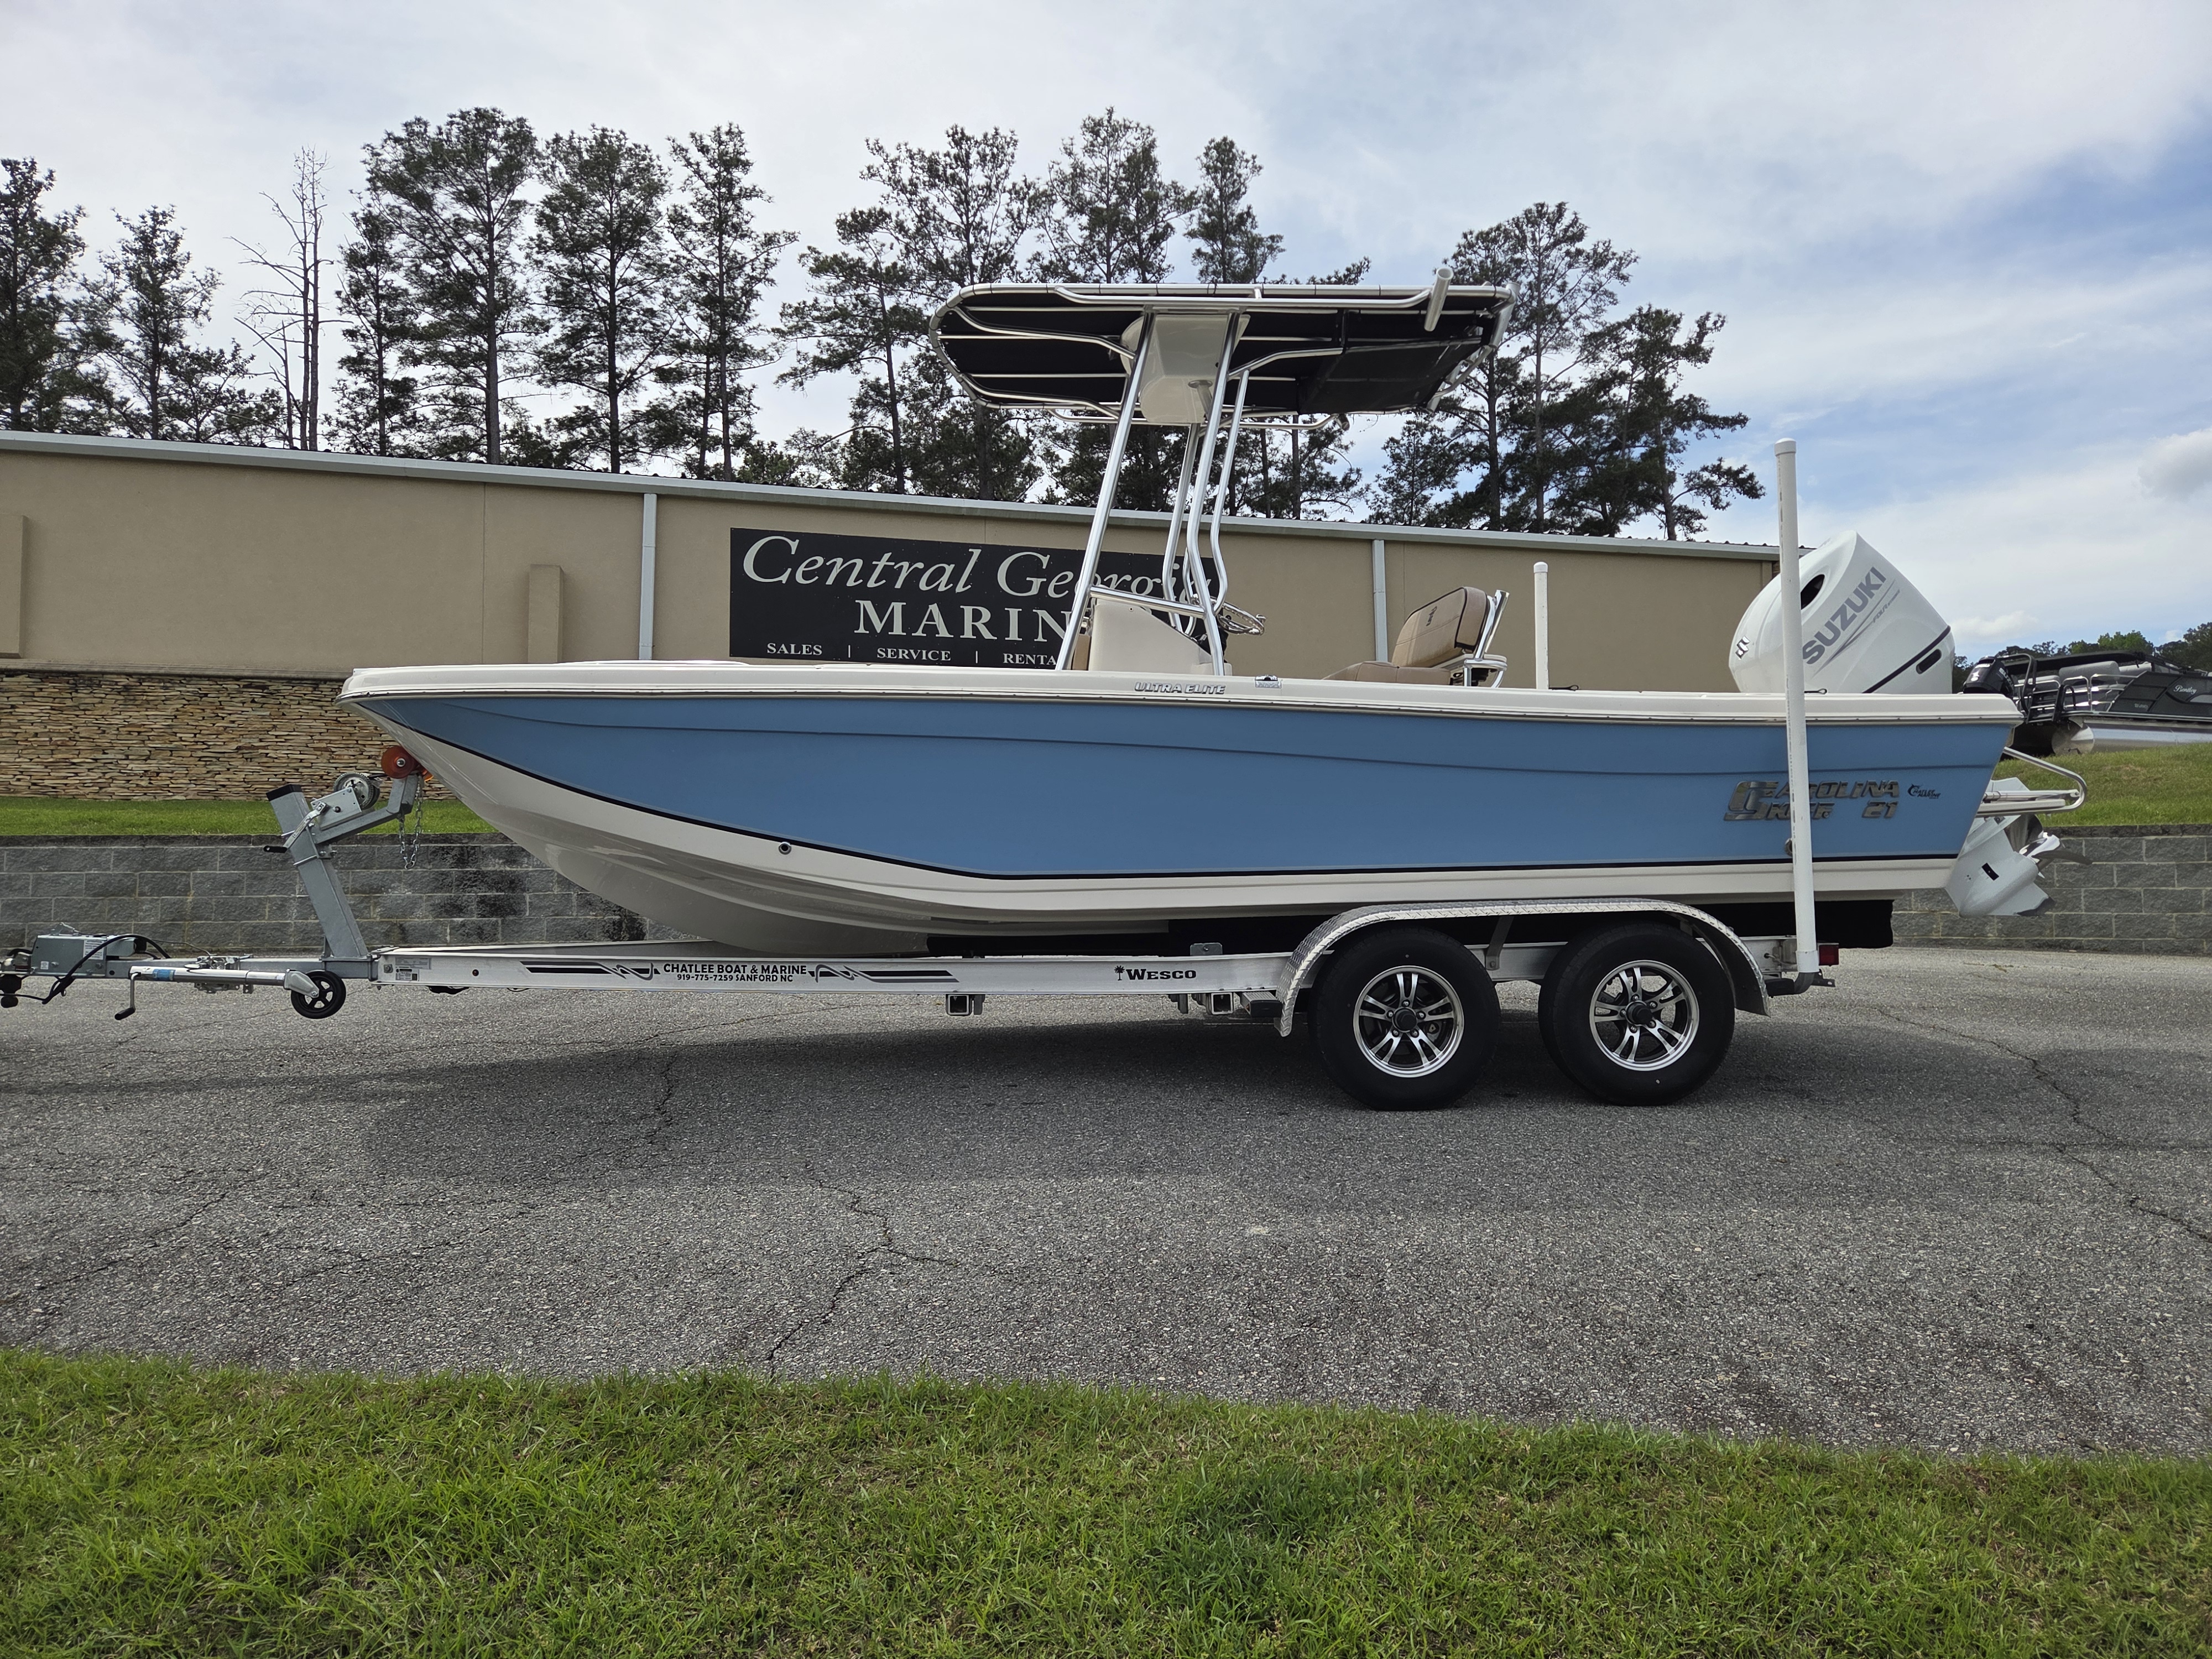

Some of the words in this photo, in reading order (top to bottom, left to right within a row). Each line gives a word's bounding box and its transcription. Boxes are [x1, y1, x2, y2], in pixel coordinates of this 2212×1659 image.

[743, 535, 982, 594] Central
[854, 599, 1076, 642] MARIN
[1802, 567, 1887, 665] SUZUKI
[767, 643, 822, 655] SALES
[877, 648, 951, 661] SERVICE
[1003, 653, 1057, 665] RENTA
[1134, 681, 1182, 693] ULTRA
[1183, 683, 1226, 695] ELITE
[2173, 685, 2197, 695] Bentley
[1861, 800, 1898, 818] 21
[663, 963, 714, 973] CHATLEE
[717, 964, 747, 974] BOAT
[750, 965, 758, 974] &
[761, 965, 807, 974] MARINE
